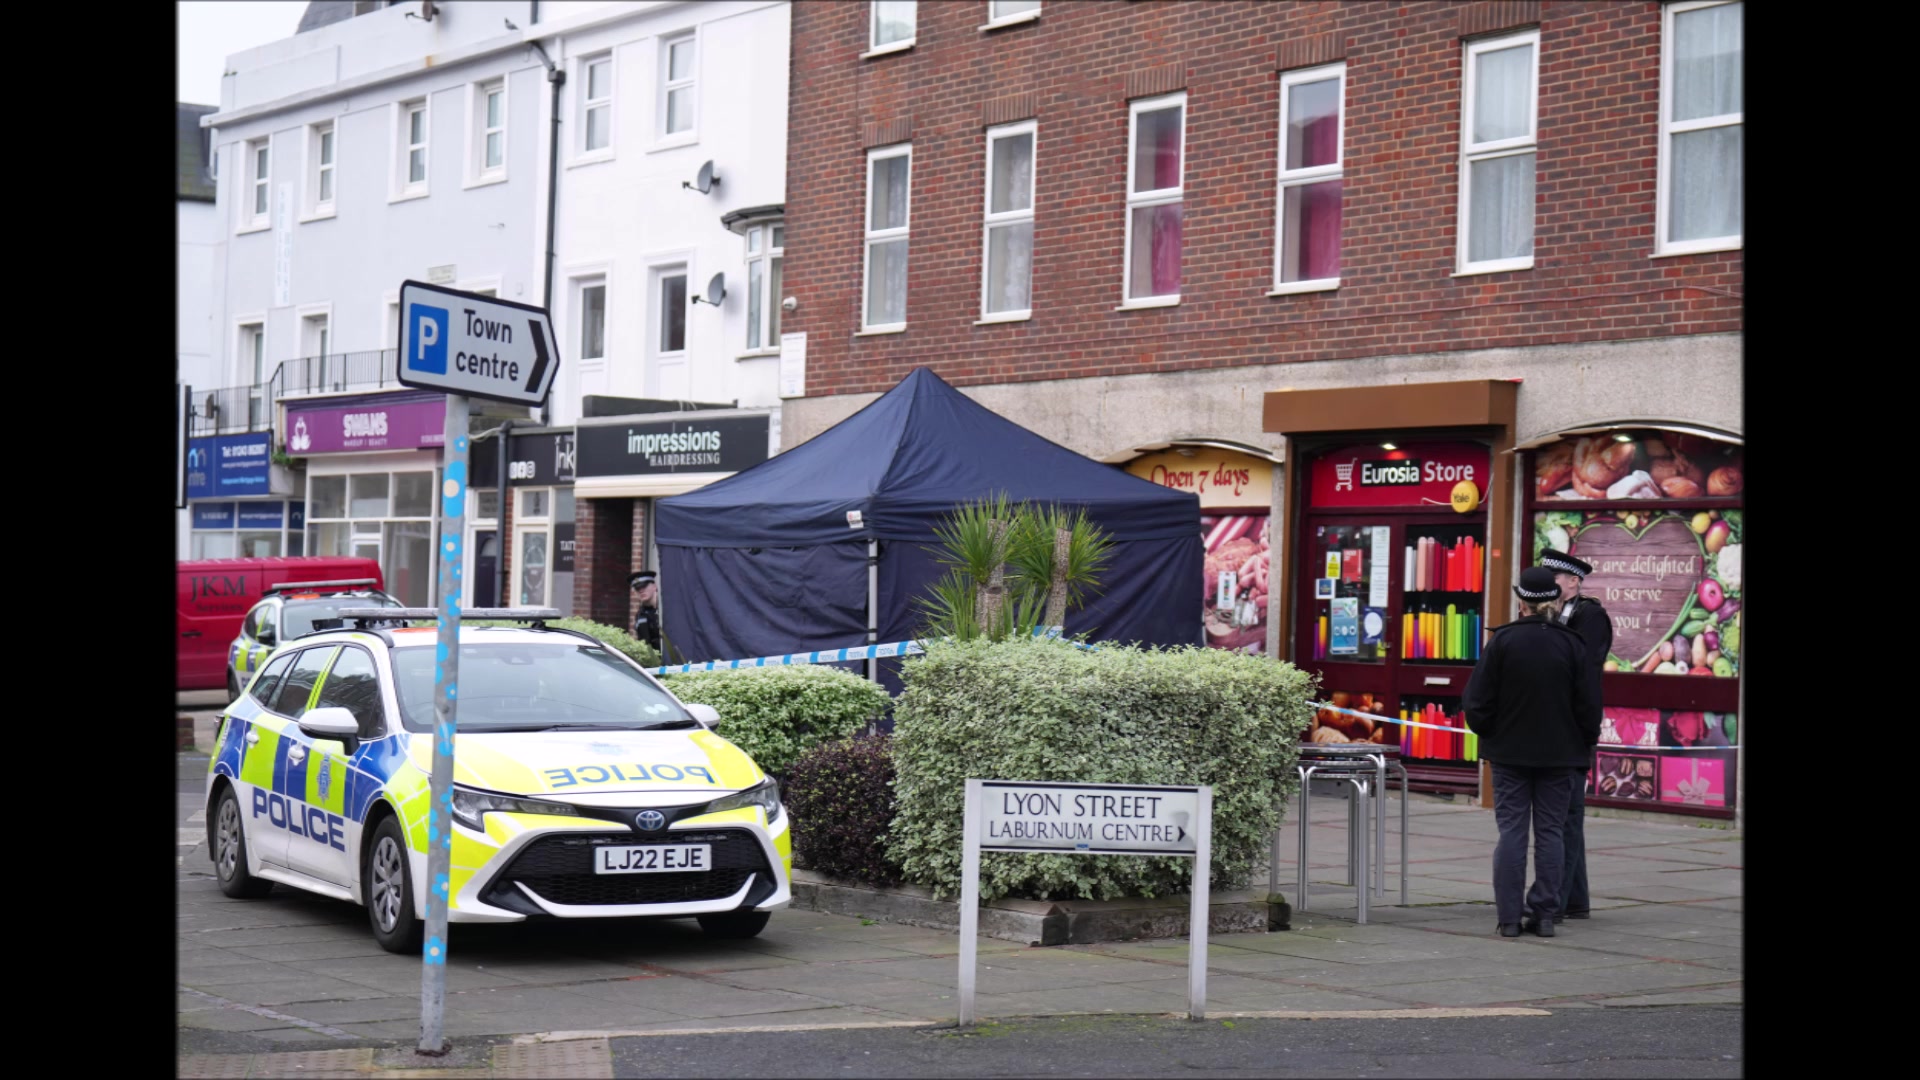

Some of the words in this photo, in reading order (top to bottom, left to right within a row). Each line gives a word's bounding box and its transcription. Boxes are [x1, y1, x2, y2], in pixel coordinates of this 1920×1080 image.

[417, 315, 439, 360] P
[464, 308, 513, 344] Town
[456, 351, 519, 381] centre
[342, 412, 388, 437] SWANS
[627, 426, 721, 459] impressions
[650, 452, 720, 466] HAIRDRESSING
[1361, 459, 1420, 485] Eurosia
[1424, 460, 1475, 482] Store
[1151, 464, 1193, 488] Open
[1199, 470, 1210, 493] 7
[1213, 462, 1250, 496] days
[1453, 492, 1471, 503] Yale
[1602, 559, 1627, 574] are
[1630, 555, 1696, 582] delighted
[189, 576, 247, 603] JKM
[1606, 587, 1620, 601] to
[1624, 588, 1663, 601] serve
[1615, 616, 1641, 636] you
[1003, 792, 1062, 816] LYON
[1073, 794, 1163, 819] STREET
[253, 786, 346, 853] POLICE
[989, 820, 1093, 840] LABURNUM
[1101, 823, 1173, 842] CENTRE
[604, 849, 658, 871] LJ22
[663, 848, 703, 869] EJE
